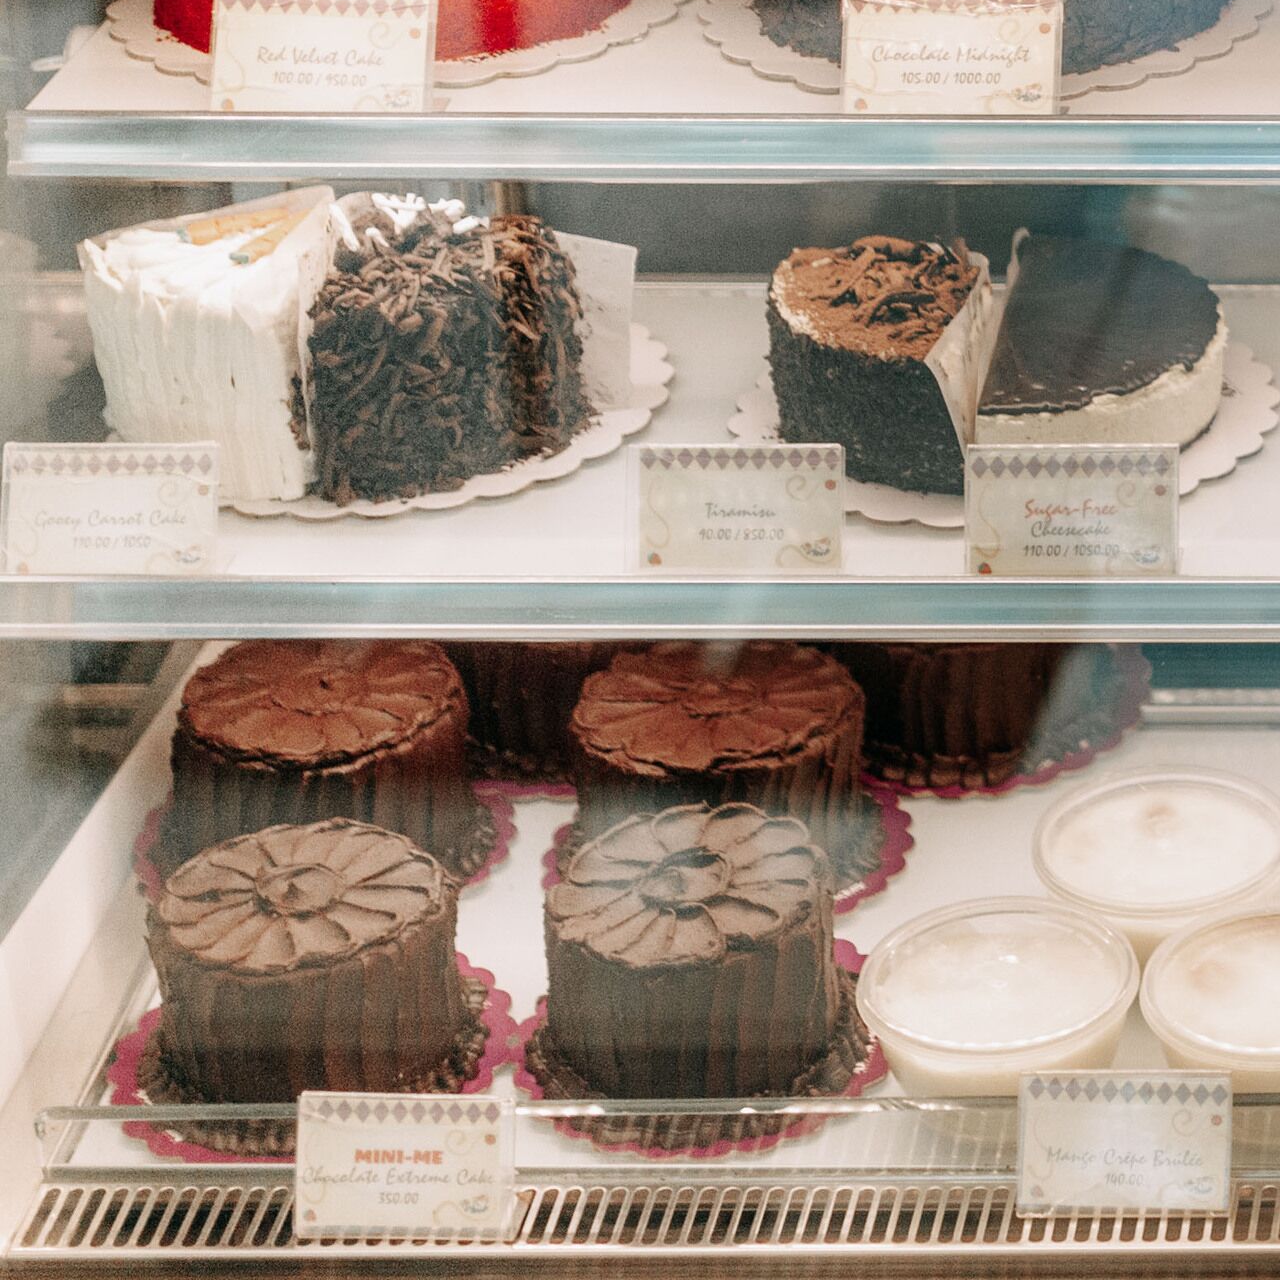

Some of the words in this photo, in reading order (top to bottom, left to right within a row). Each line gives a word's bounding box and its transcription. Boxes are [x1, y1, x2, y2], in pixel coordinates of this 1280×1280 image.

[256, 46, 288, 65] Red
[292, 46, 340, 66] Velvet
[344, 47, 383, 67] Cake
[872, 45, 950, 63] Chocolate
[956, 46, 1030, 68] Midnight
[901, 72, 940, 85] 105.00
[954, 72, 1001, 85] 1000.00
[705, 502, 777, 519] Tiramisu
[1024, 498, 1118, 521] Sugar-Free
[1031, 520, 1112, 538] Cheesecake
[1022, 544, 1061, 557] 110.00
[354, 1148, 444, 1165] MINI-ME
[302, 1167, 379, 1185] Chocolate
[386, 1168, 449, 1185] Extreme
[457, 1168, 496, 1185] Cake
